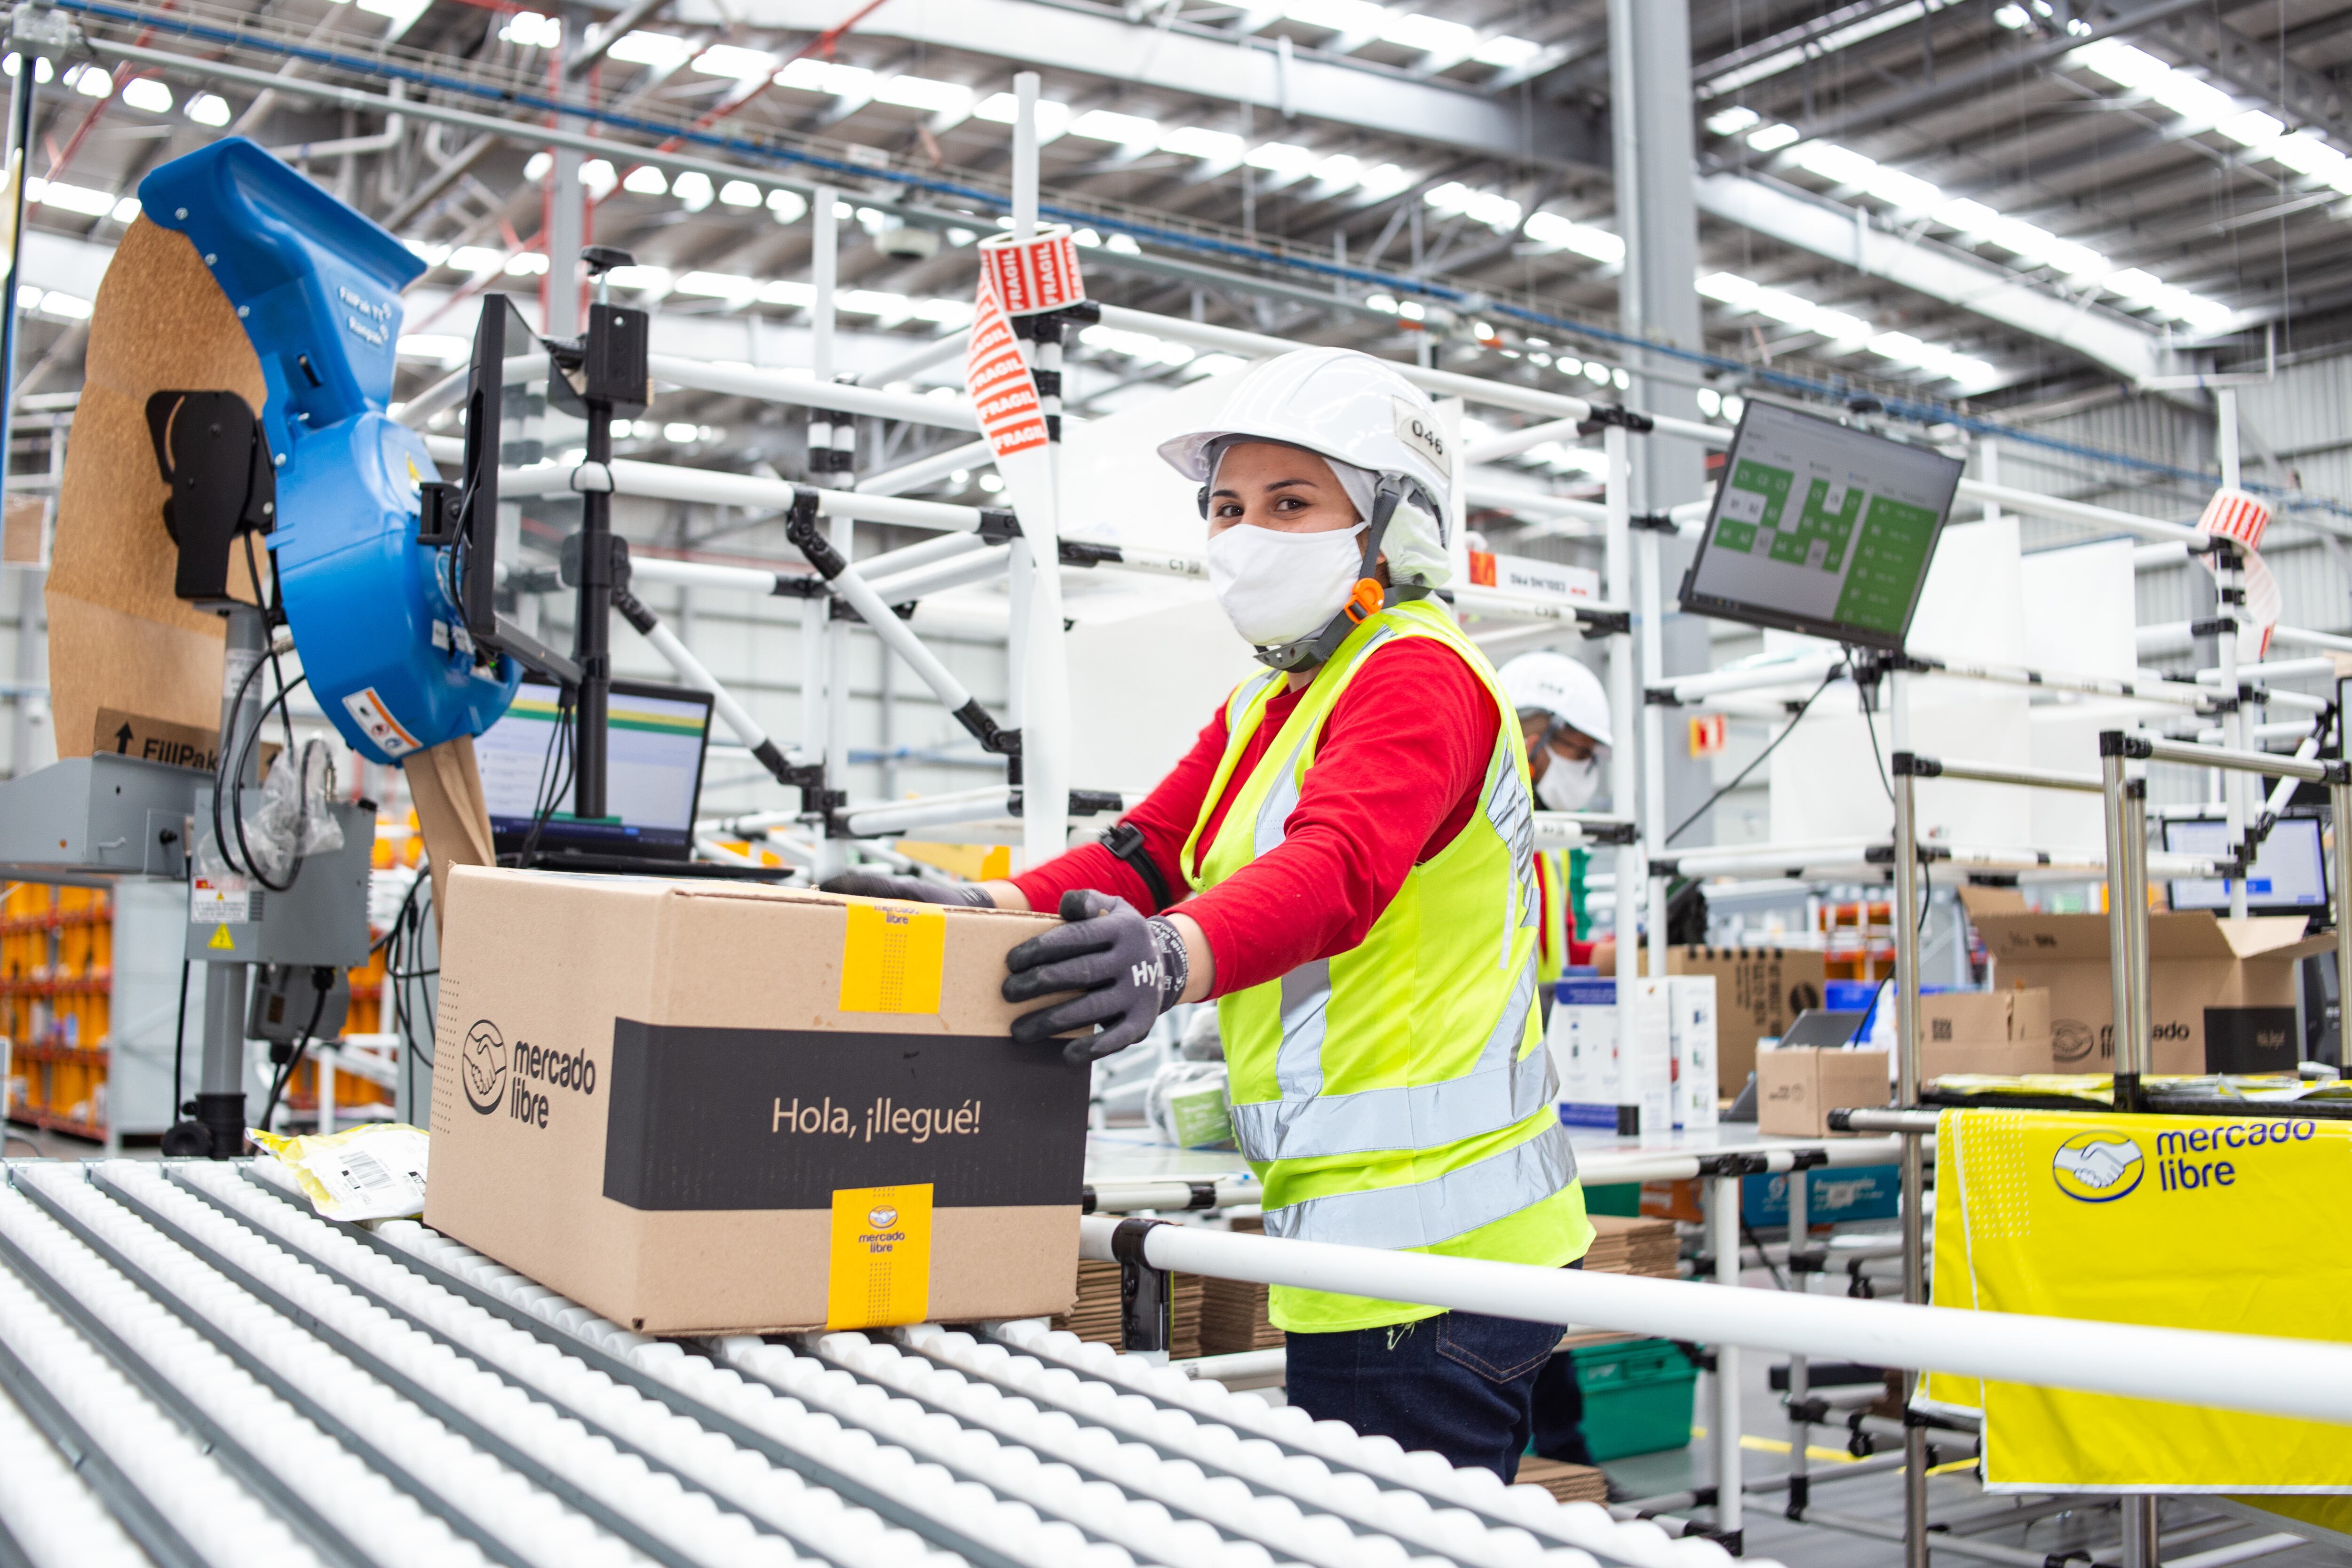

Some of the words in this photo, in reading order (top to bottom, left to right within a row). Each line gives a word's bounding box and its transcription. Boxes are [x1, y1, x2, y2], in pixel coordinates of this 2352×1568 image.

[1001, 248, 1025, 310] FRAGIL
[1036, 242, 1059, 305] FRAGIL
[979, 390, 1036, 419] FRAGIL
[994, 426, 1046, 449] FRAGIL
[1412, 420, 1442, 455] 046
[143, 737, 217, 771] FillPak
[886, 912, 909, 924] libre
[1131, 956, 1164, 987] Hy
[514, 1040, 596, 1095] mercado
[510, 1076, 549, 1129] libre
[772, 1096, 857, 1139] Hola,
[865, 1097, 981, 1144] ¡llegué!
[2156, 1118, 2316, 1156] mercado
[2159, 1158, 2236, 1191] libre
[858, 1230, 905, 1243] mercado
[870, 1242, 893, 1253] libre
